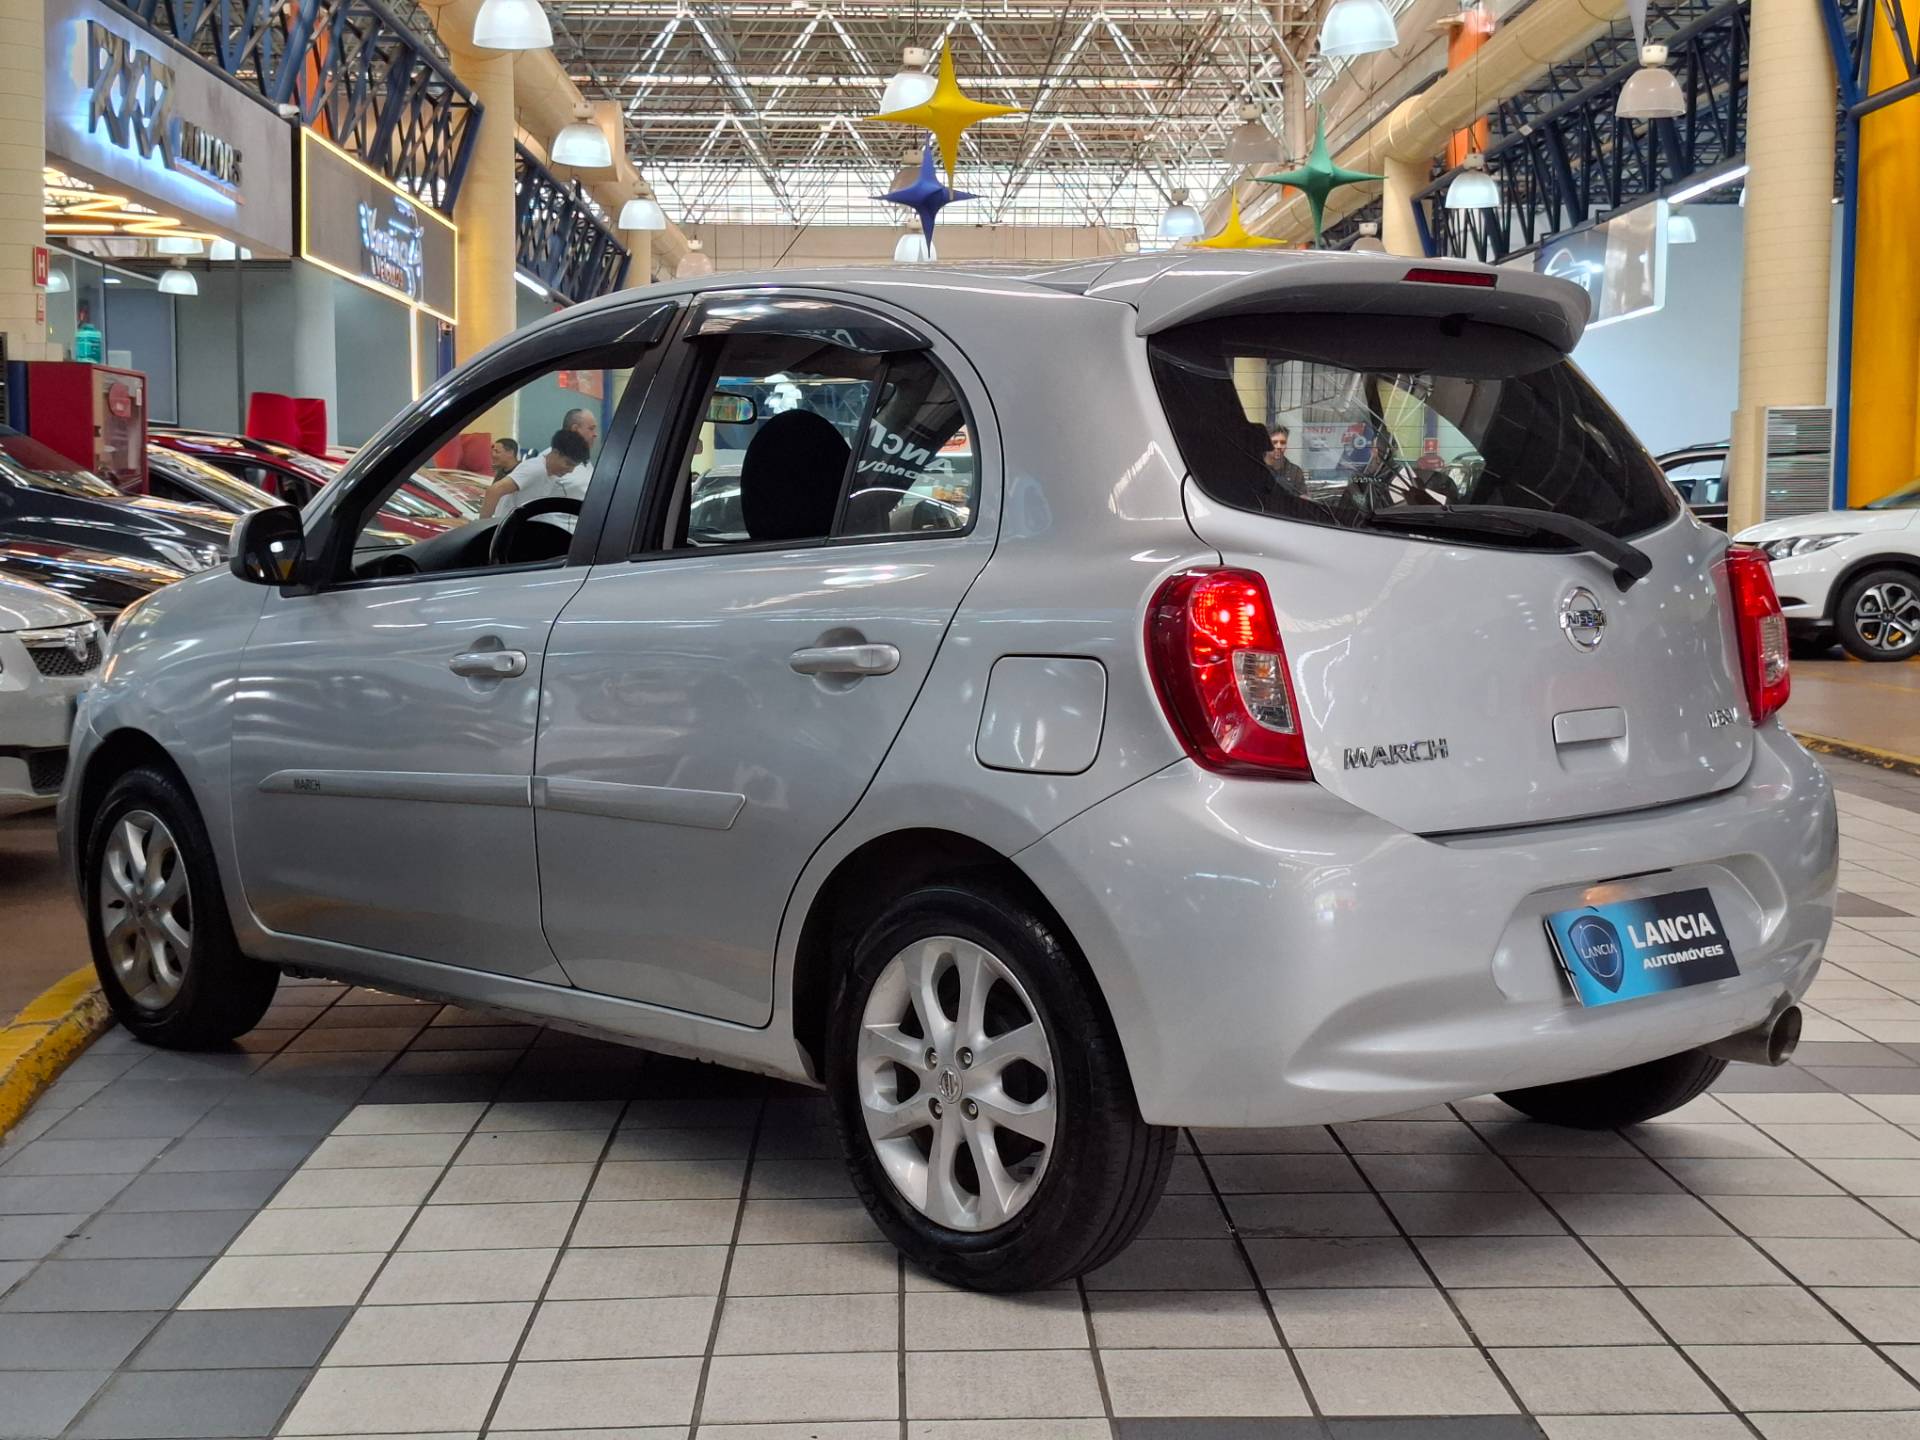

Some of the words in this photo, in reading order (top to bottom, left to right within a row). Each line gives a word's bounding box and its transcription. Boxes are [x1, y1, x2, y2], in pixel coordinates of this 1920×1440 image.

[181, 120, 242, 188] MOTORS
[37, 254, 46, 278] H
[1343, 737, 1449, 770] MARCH
[1627, 912, 1716, 949] LANCIA
[1581, 943, 1618, 960] LANCIA
[1643, 944, 1724, 970] AUTOMÓVEIS
